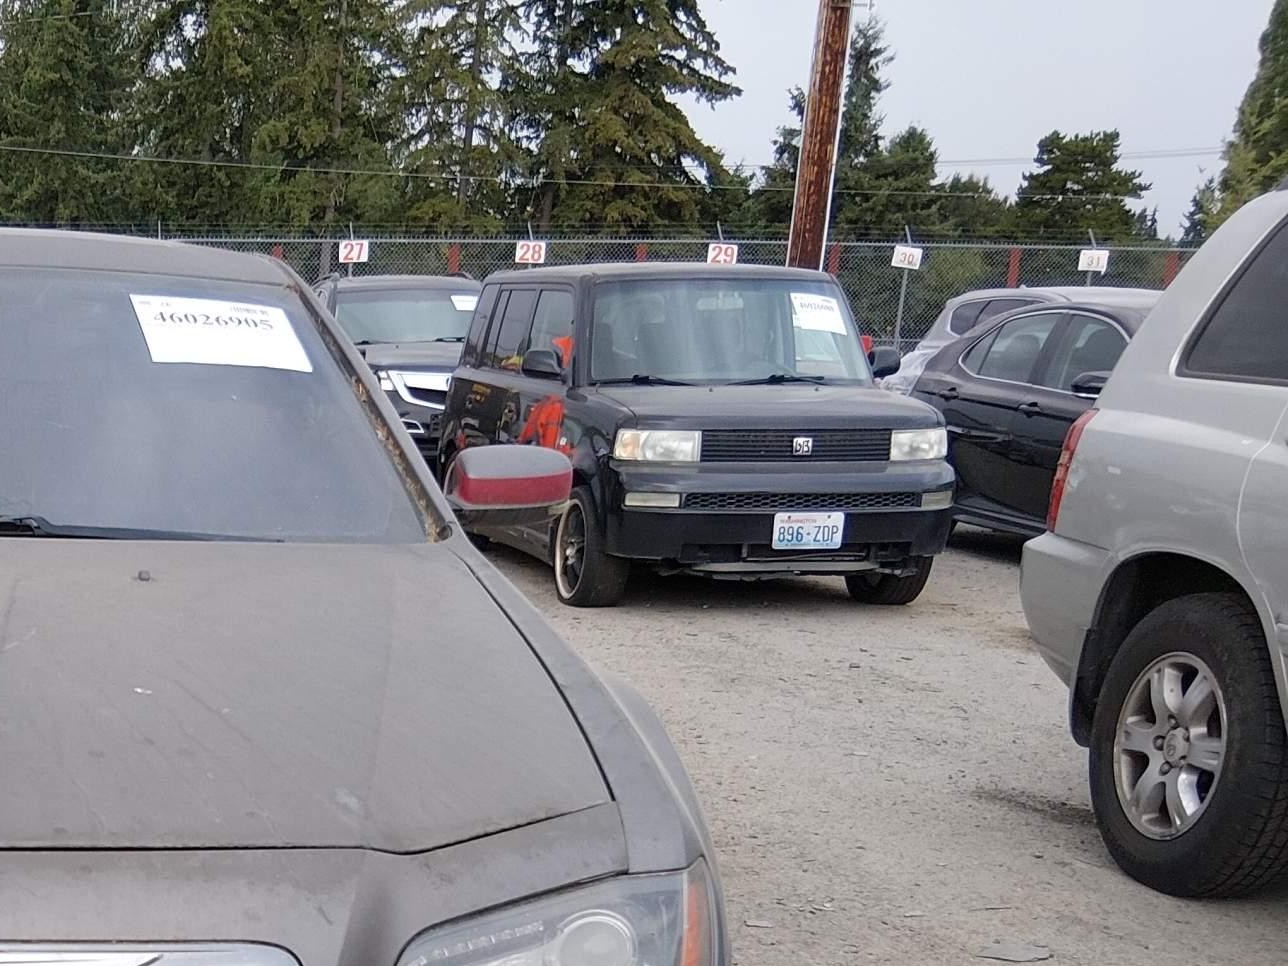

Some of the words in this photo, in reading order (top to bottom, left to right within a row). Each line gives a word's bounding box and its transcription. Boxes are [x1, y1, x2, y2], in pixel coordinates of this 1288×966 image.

[343, 243, 365, 261] 27
[519, 243, 543, 261] 28
[710, 245, 735, 264] 29
[899, 252, 915, 264] 30
[1087, 255, 1101, 267] 31
[154, 311, 274, 331] 46026905
